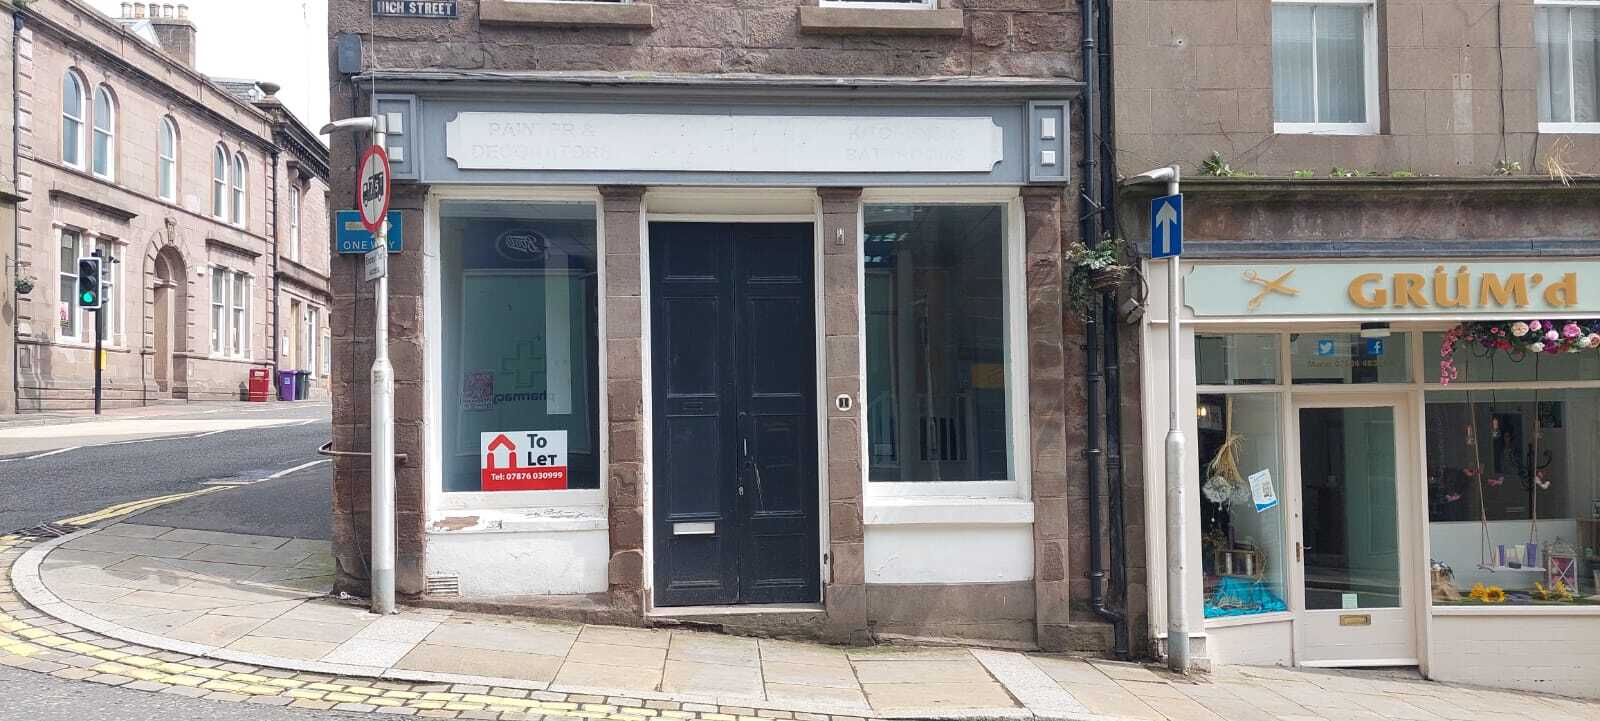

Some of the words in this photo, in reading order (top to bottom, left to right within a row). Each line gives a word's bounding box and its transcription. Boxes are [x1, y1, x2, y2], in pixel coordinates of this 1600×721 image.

[409, 2, 453, 16] STREET
[488, 121, 577, 138] PAINER
[343, 240, 368, 250] ONE
[526, 433, 548, 449] To
[491, 473, 505, 481] Tel:
[506, 472, 532, 480] 07876
[532, 471, 563, 480] 030999
